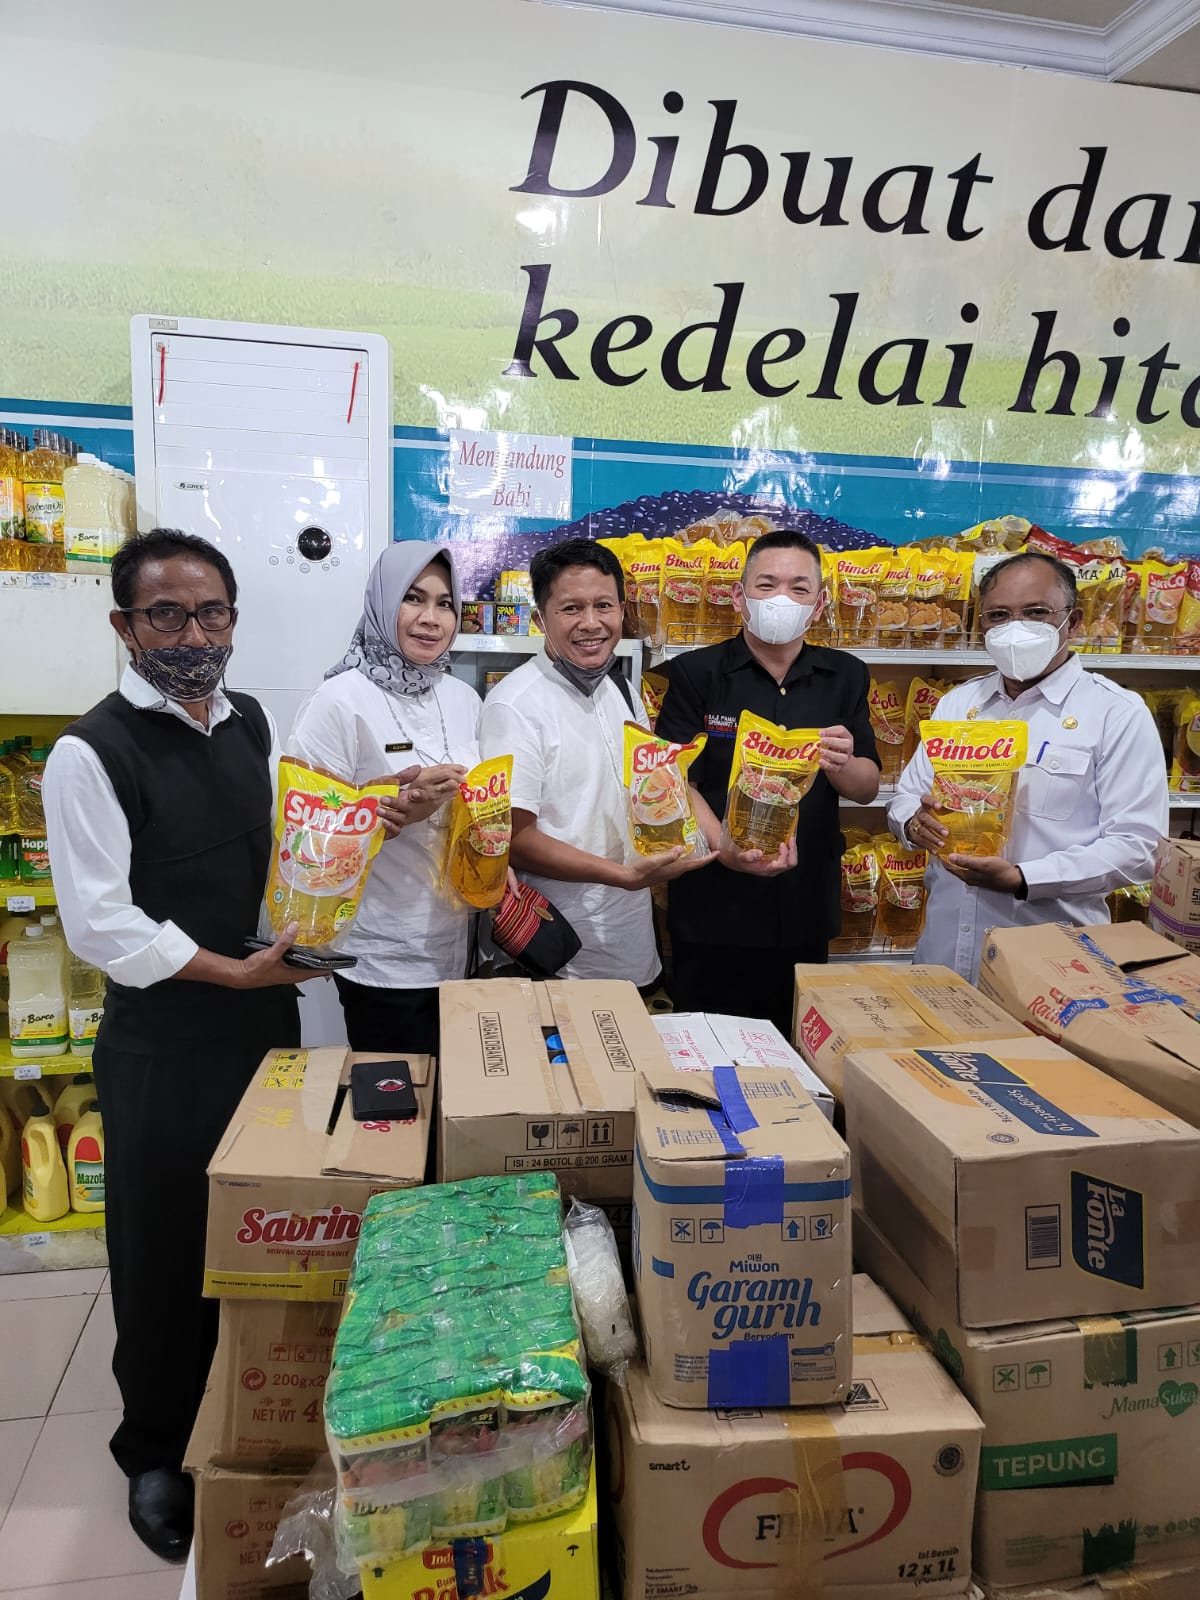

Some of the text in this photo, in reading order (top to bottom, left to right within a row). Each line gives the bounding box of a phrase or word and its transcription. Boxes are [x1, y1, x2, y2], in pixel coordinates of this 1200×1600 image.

[508, 79, 994, 242] Dibuat
[502, 263, 982, 409] kedelai
[458, 440, 566, 479] Menandung
[491, 482, 532, 508] Babi
[77, 532, 100, 542] Barco
[665, 553, 703, 569] Bimoli
[837, 559, 883, 575] Bimoli
[497, 606, 515, 615] SPAM
[743, 730, 822, 762] Bimoli
[926, 737, 1015, 760] Bimoli
[286, 795, 373, 833] SunCo
[884, 853, 926, 871] Bimoli
[27, 1013, 55, 1024] Barco
[481, 1015, 505, 1074] JANGAN DIBANTING
[597, 1012, 631, 1069] JANGAN DIBANTING
[512, 1159, 524, 1168] ISI
[531, 1158, 542, 1167] 24
[543, 1157, 573, 1167] BOTOL
[575, 1156, 584, 1167] @
[585, 1155, 600, 1165] 200
[601, 1154, 628, 1164] GRAM
[1086, 1180, 1115, 1270] Fonte
[729, 1260, 780, 1274] Miwon
[687, 1271, 813, 1310] Garam
[712, 1290, 821, 1341] gurih
[253, 1400, 319, 1423] NET WT 4
[992, 1447, 1106, 1478] TEPUNG
[898, 1557, 956, 1578] 12 x 1L
[656, 1585, 683, 1594] SMART
